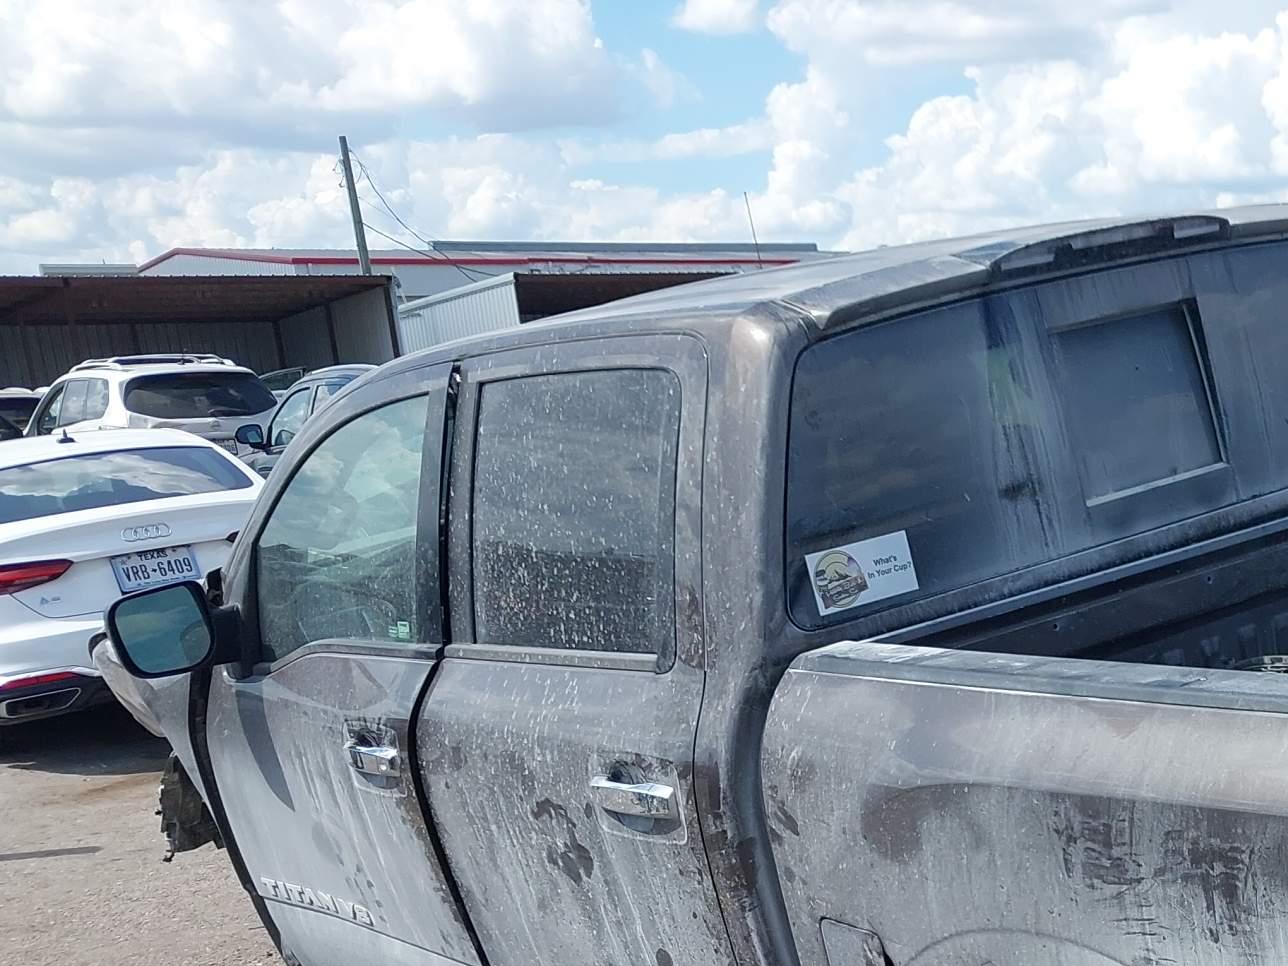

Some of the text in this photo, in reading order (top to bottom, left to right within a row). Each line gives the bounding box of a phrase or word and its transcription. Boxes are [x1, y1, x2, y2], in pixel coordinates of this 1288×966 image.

[137, 550, 168, 562] TEXAS
[873, 554, 897, 567] What's
[867, 561, 912, 580] In Your Cup?
[261, 876, 339, 914] TITAN
